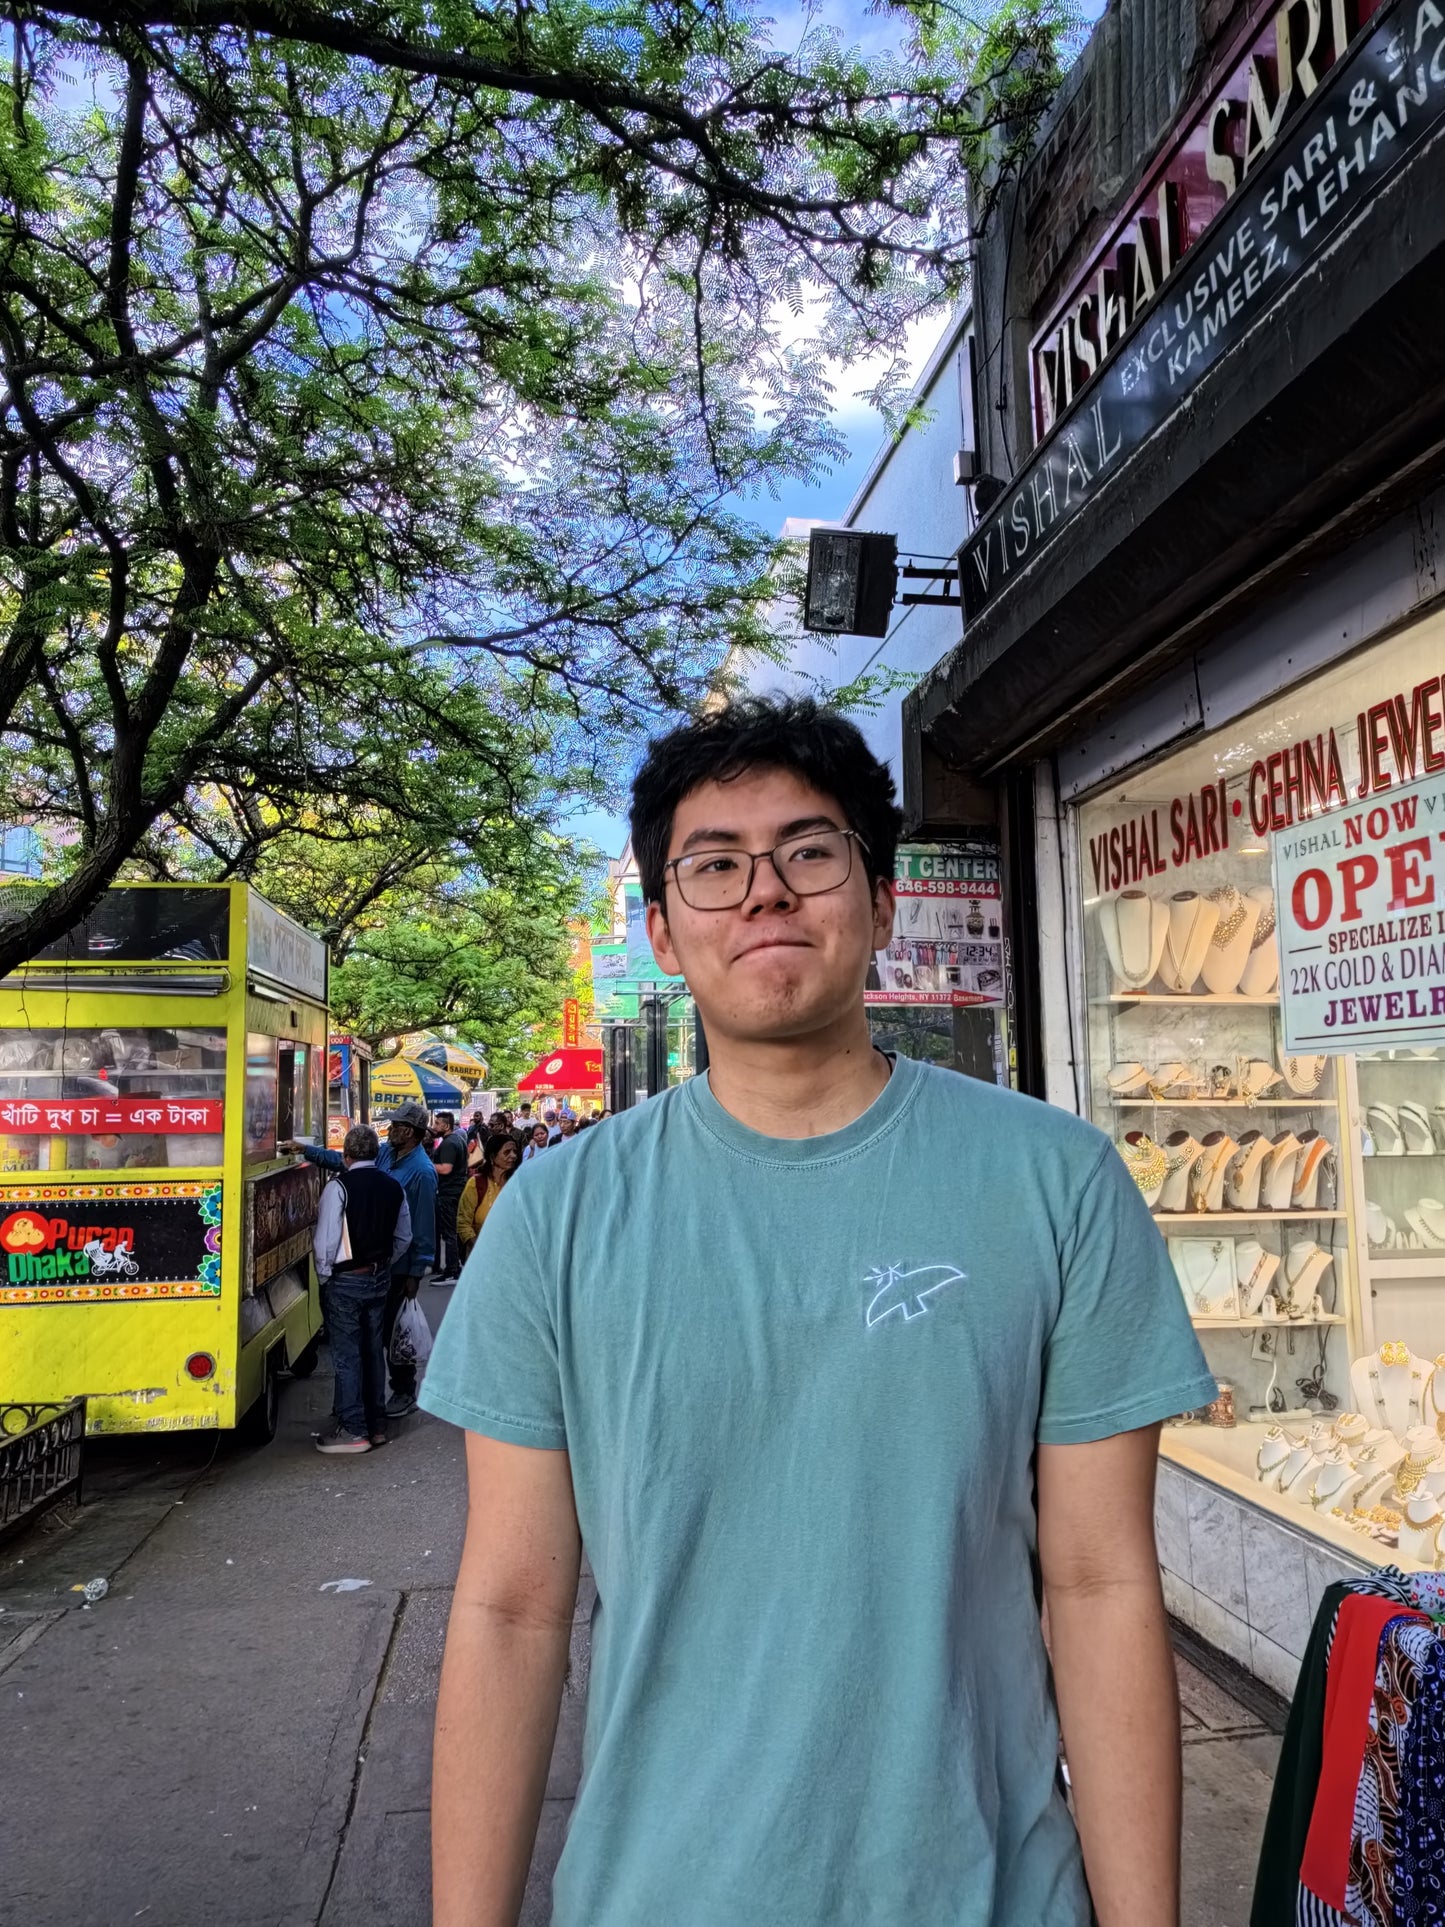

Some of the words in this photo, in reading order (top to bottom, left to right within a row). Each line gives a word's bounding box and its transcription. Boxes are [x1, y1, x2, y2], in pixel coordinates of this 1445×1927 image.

[1039, 181, 1172, 437] VISHAL
[1206, 0, 1348, 200] SARI
[1121, 216, 1255, 397] EXCLUSIVE
[1260, 116, 1338, 231] SARI
[1348, 78, 1377, 128] &
[1167, 233, 1290, 385] KAMEEZ,
[972, 396, 1121, 593] VISHAL
[1089, 808, 1167, 896] VISHAL
[1170, 777, 1229, 868] SARI
[1357, 673, 1445, 799] JEWE
[1283, 829, 1342, 860] VISHAL
[1343, 795, 1419, 849] NOW
[896, 880, 996, 896] 646-598-9444
[920, 857, 998, 880] CENTER
[1291, 831, 1445, 931] OPE
[1328, 914, 1432, 955] SPECIALIZE
[1290, 964, 1322, 995] 22K
[1324, 954, 1376, 991] GOLD
[1381, 951, 1394, 983] &
[1400, 942, 1445, 980] DIA
[449, 1066, 482, 1076] SABRETT
[0, 1103, 40, 1126] খাঁটি
[45, 1109, 74, 1129] দুধ
[79, 1109, 100, 1126] চা
[105, 1113, 122, 1123] =
[129, 1108, 163, 1126] এক
[167, 1105, 210, 1126] টাকা
[8, 1248, 90, 1282] Dhaka
